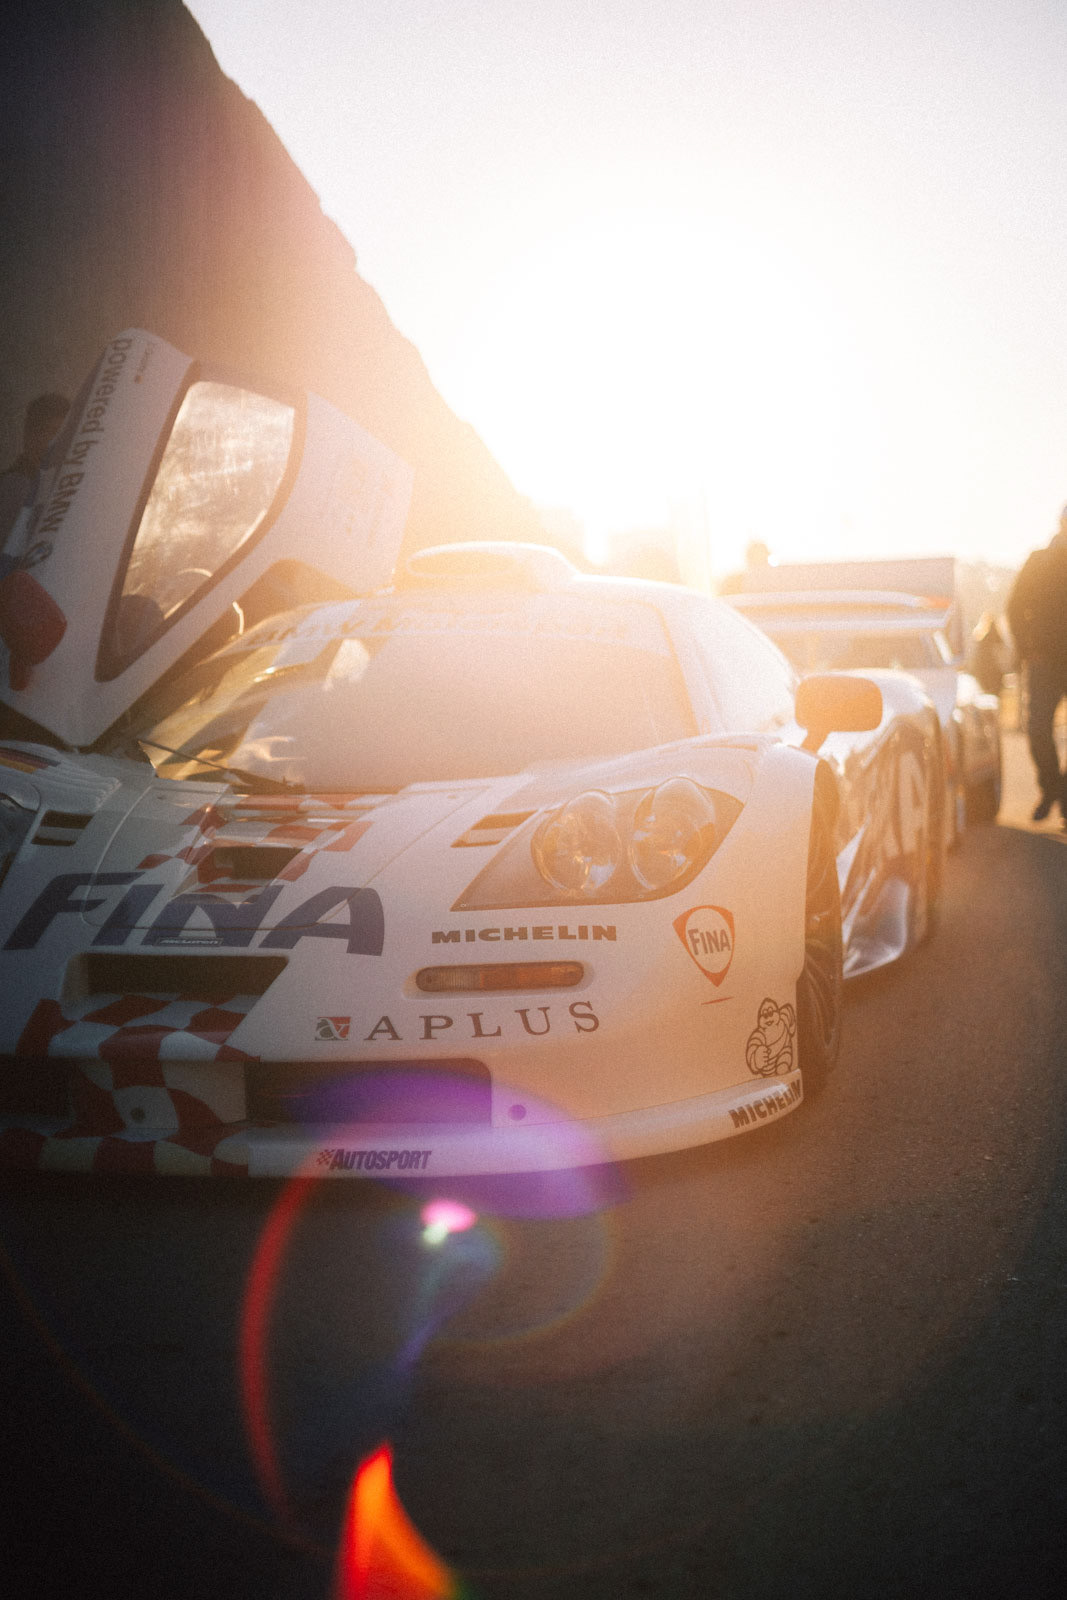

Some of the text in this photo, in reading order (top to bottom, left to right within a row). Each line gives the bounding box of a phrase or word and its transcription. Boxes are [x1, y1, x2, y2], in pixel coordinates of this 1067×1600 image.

[39, 338, 132, 534] powered by BMW
[3, 871, 385, 957] FINA
[431, 924, 617, 944] MICHELIN
[688, 927, 731, 956] FINA
[363, 1000, 600, 1041] APLUS
[728, 1079, 801, 1128] MICHELIN
[329, 1149, 432, 1170] AUTOSPORT
